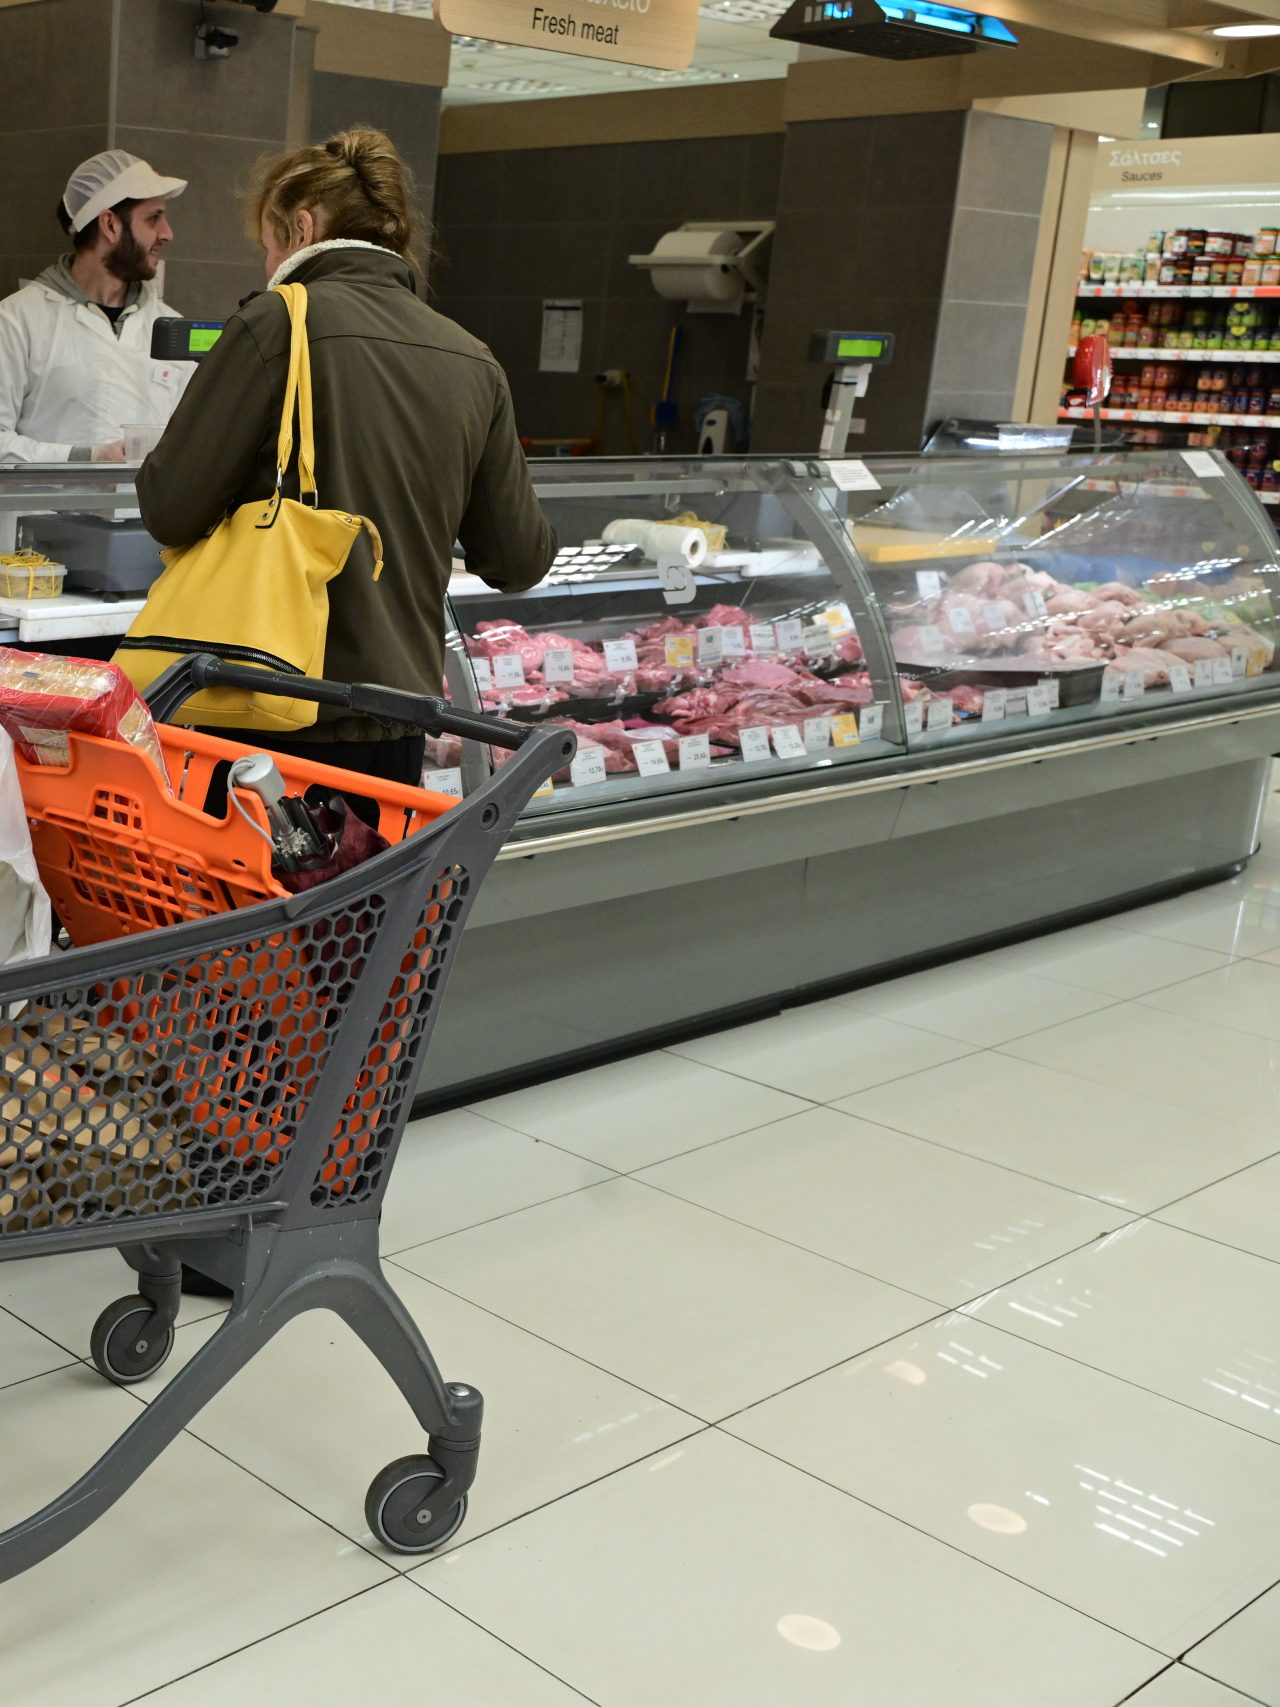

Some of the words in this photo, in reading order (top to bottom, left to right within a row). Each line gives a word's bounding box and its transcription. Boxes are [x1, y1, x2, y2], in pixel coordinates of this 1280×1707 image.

[532, 8, 576, 37] Fresh
[580, 21, 619, 45] meat
[1109, 149, 1182, 167] Σάλτσες
[1121, 171, 1162, 182] Sauces
